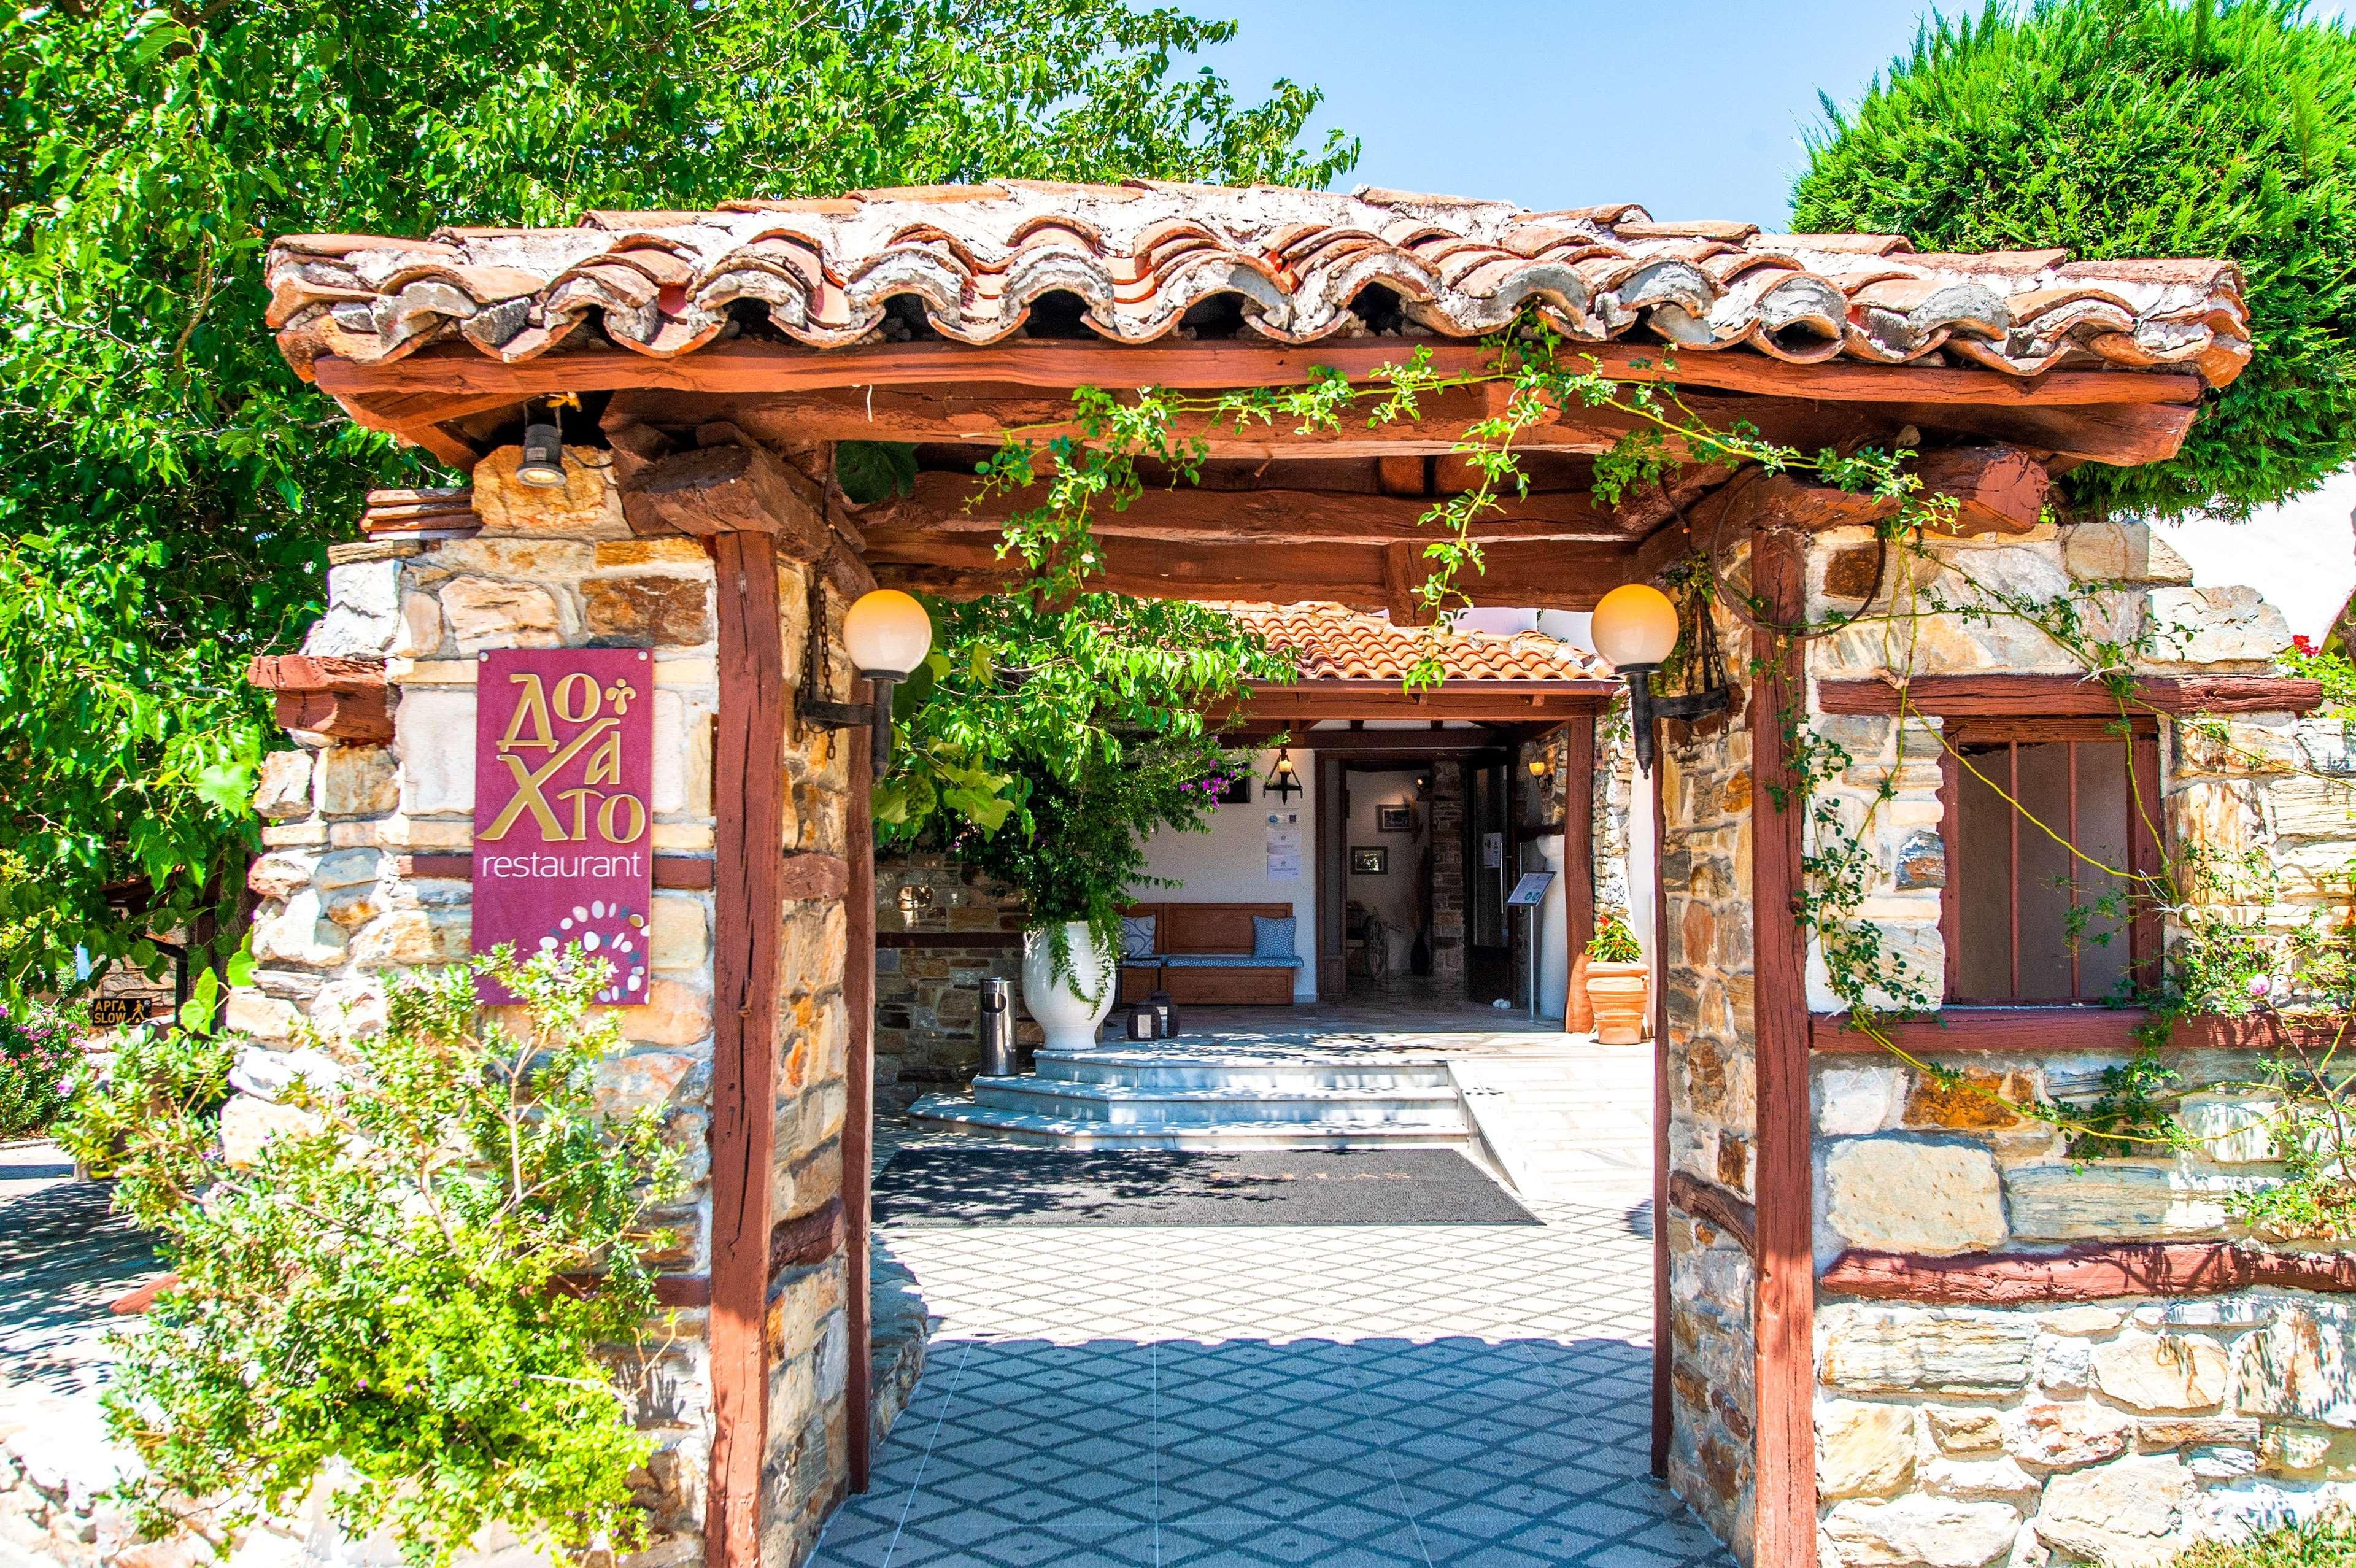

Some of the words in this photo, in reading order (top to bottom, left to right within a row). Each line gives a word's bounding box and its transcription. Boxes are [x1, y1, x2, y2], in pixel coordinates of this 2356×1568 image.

[482, 852, 642, 878] restaurant
[95, 1000, 126, 1011] ΑΡΓΑ
[94, 1012, 126, 1024] SLOW
